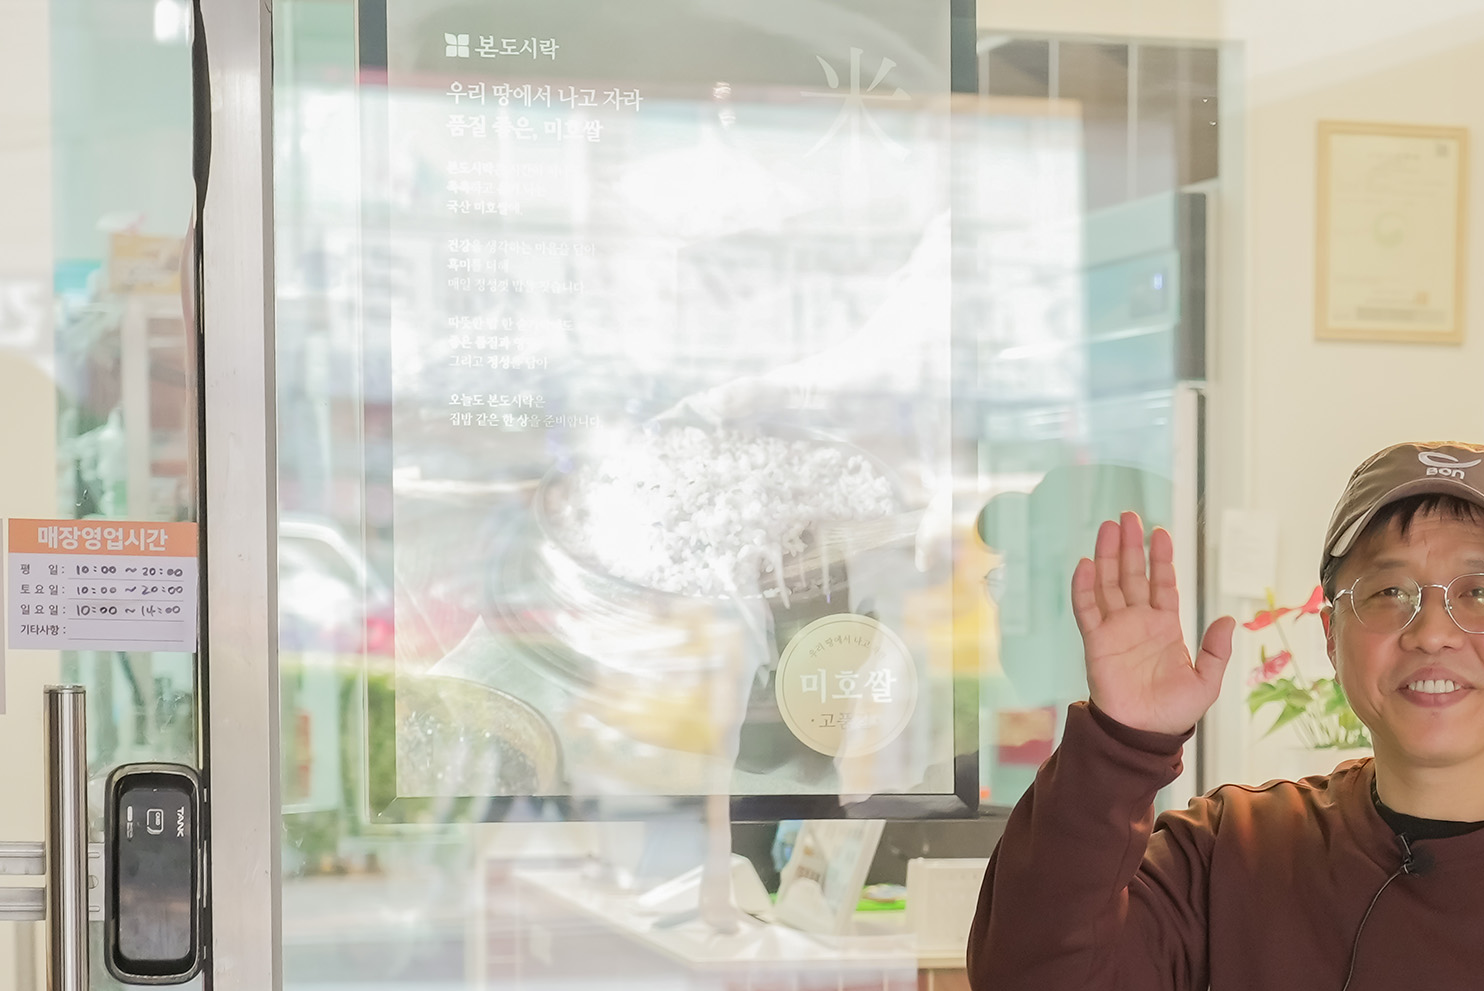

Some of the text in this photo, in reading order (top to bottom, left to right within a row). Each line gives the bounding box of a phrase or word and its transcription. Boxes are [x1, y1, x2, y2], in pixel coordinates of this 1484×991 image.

[474, 35, 560, 60] 본도시락
[446, 80, 645, 112] 우리 땅에서 나고 자라
[800, 46, 913, 163] 米
[445, 113, 487, 138] 품질
[543, 117, 605, 143] 미호쌀
[446, 200, 471, 215] 국산
[448, 354, 485, 369] 그리고
[448, 392, 548, 410] 오늘도 본도시락은
[449, 412, 474, 428] 집밥
[475, 412, 500, 428] 같은
[501, 413, 514, 428] 한
[37, 525, 169, 552] 매장영업시간
[799, 667, 898, 704] 미호쌀
